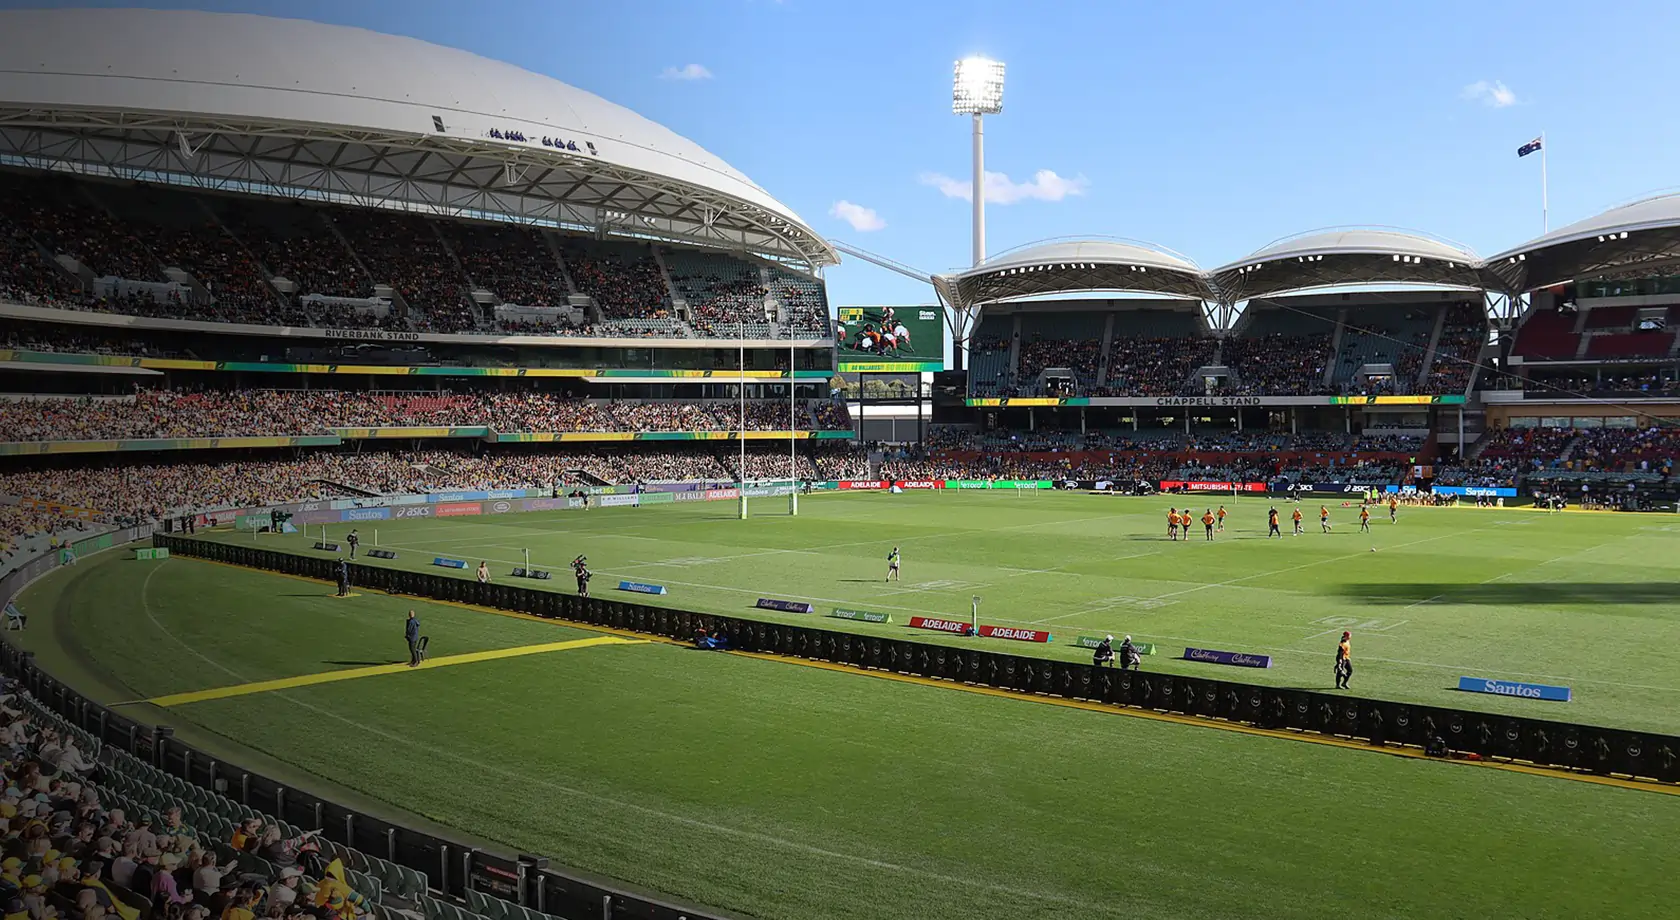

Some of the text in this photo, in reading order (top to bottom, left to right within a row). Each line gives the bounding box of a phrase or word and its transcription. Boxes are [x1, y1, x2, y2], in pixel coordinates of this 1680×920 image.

[325, 329, 419, 341] RIVERBANK STAND
[1157, 397, 1260, 406] CHAPPELL STAND
[589, 485, 615, 494] bet365
[1191, 483, 1229, 491] MITSUBISHI
[708, 488, 737, 499] ADELAIDE
[348, 509, 382, 520] Santos
[406, 506, 430, 517] asics
[627, 582, 652, 592] Santos
[921, 618, 963, 632] ADELAIDE
[990, 627, 1036, 640] ADELAIDE
[1190, 649, 1262, 667] Cadbury Cadbury
[1483, 680, 1542, 699] Santos
